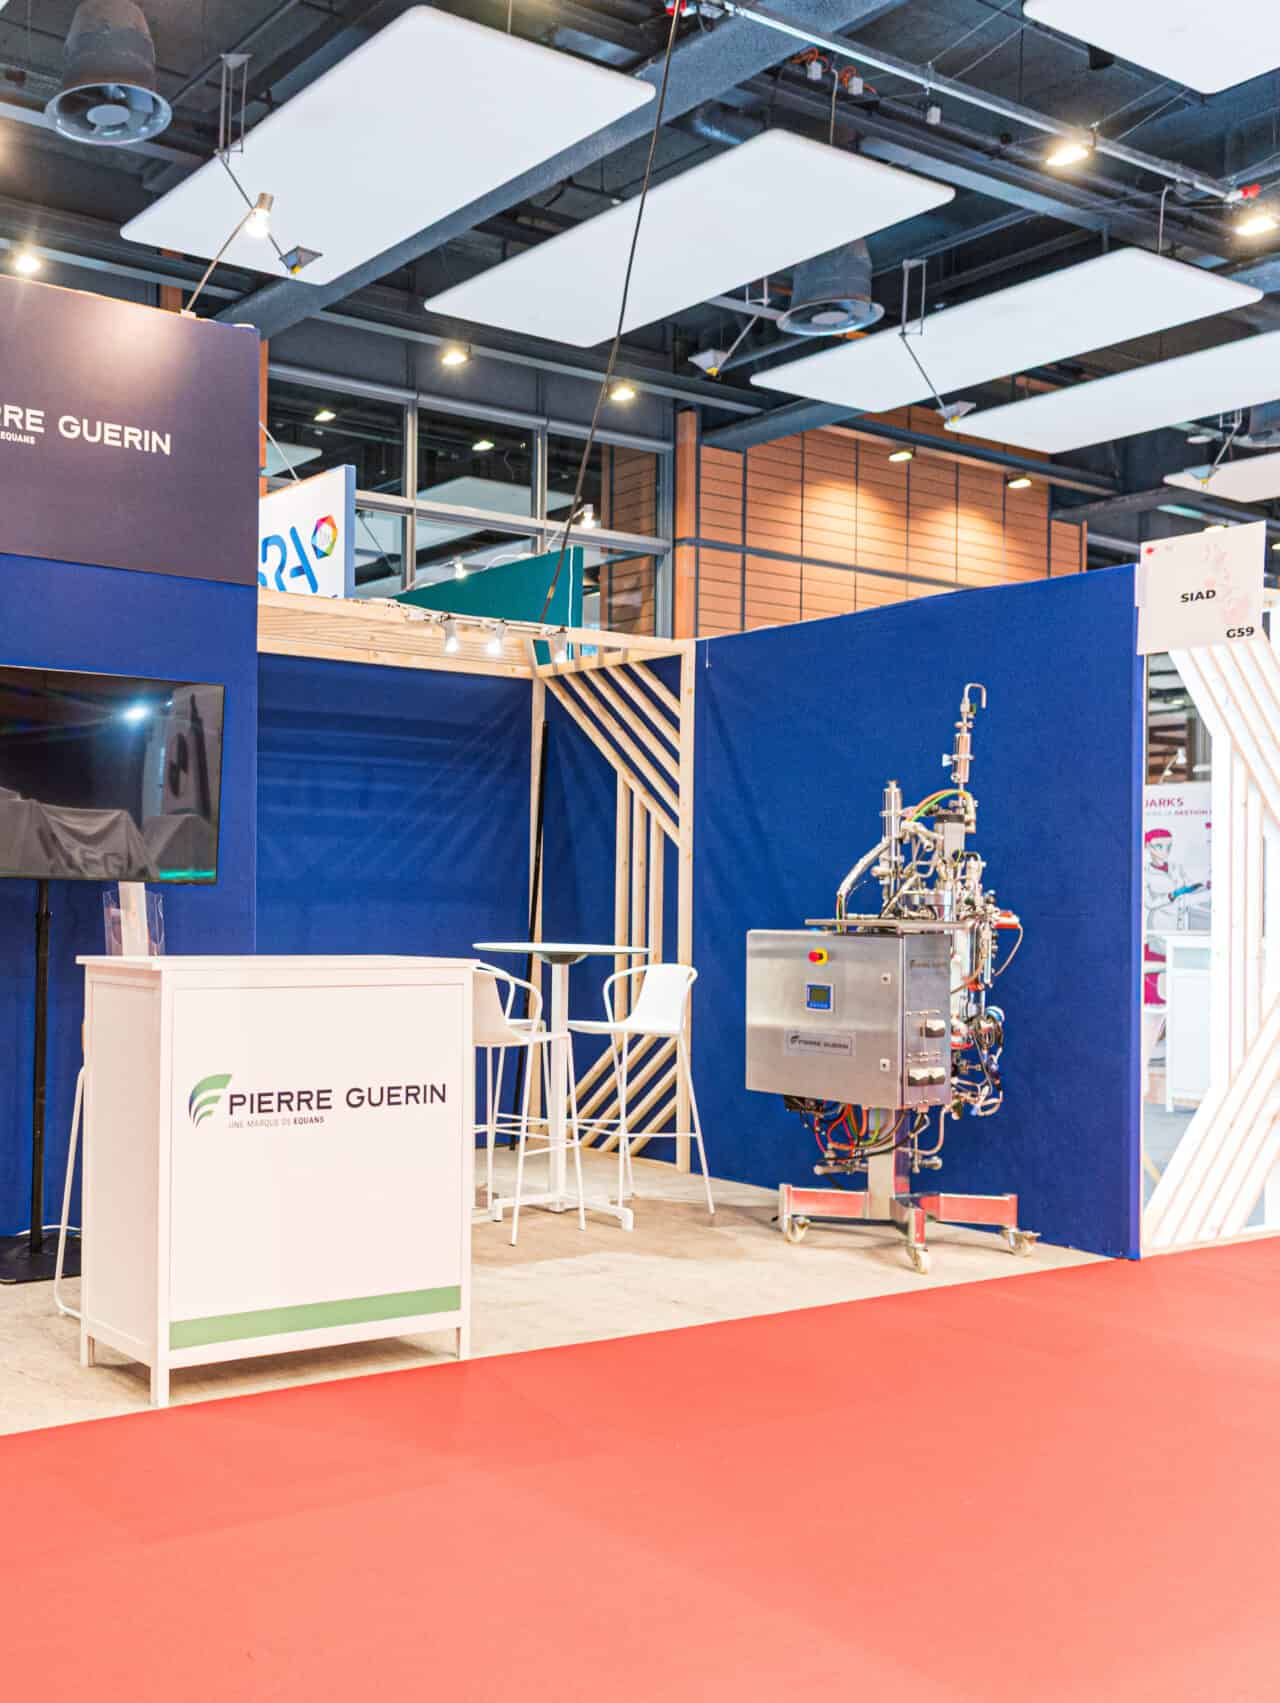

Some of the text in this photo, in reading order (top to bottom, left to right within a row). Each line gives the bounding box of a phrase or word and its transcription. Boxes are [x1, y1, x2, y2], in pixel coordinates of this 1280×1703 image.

[58, 415, 171, 456] GUERIN
[1180, 589, 1216, 603] SIAD
[1226, 626, 1255, 639] G59
[229, 1083, 447, 1116] PIERRE GUERIN
[293, 1116, 325, 1126] EQUANS
